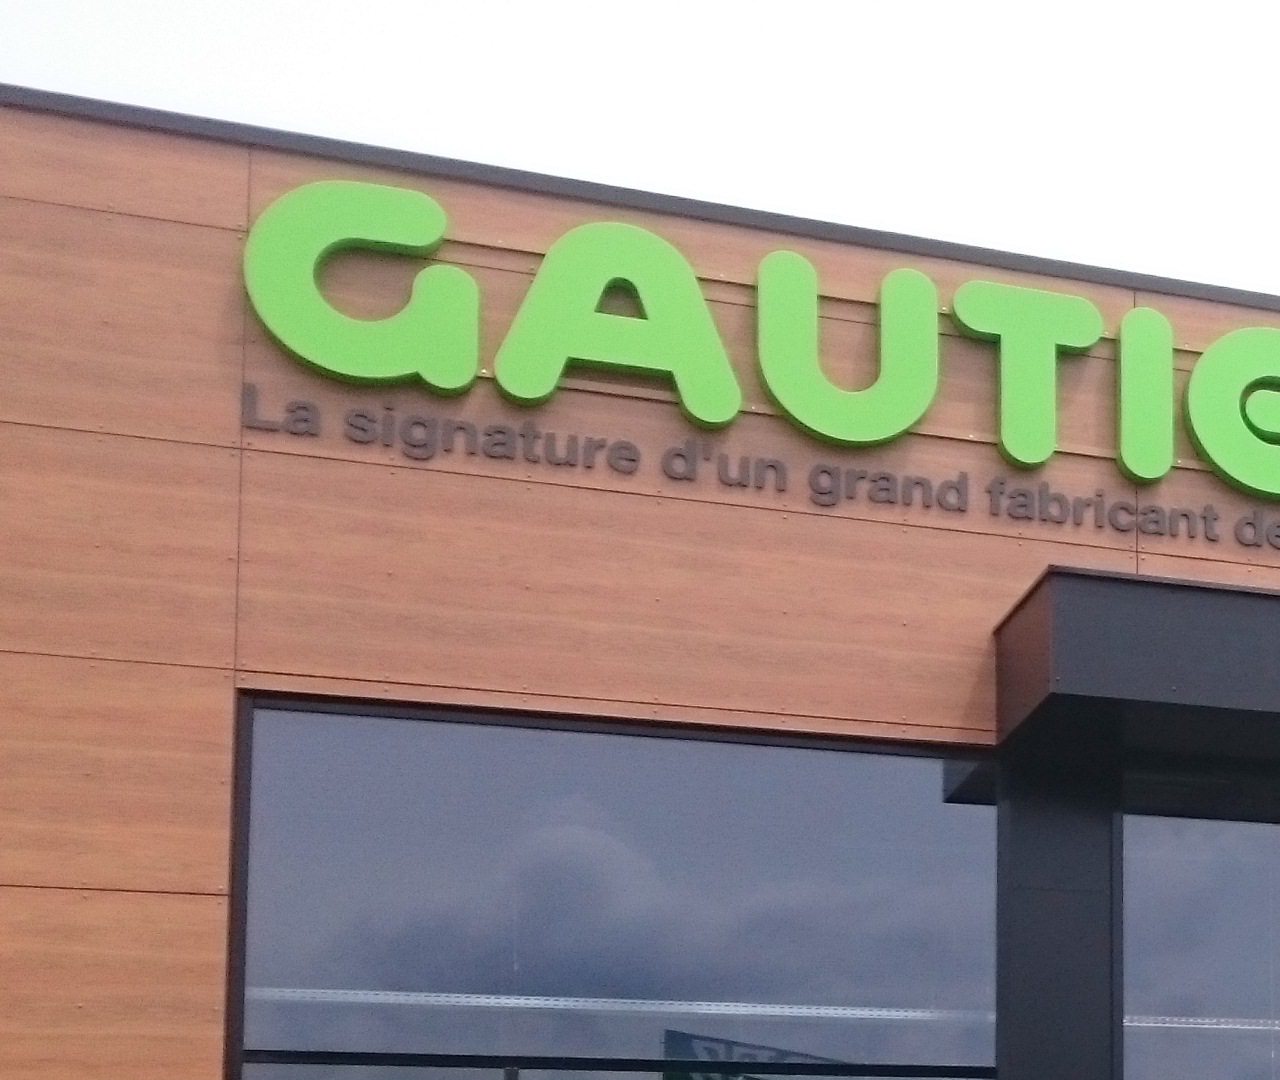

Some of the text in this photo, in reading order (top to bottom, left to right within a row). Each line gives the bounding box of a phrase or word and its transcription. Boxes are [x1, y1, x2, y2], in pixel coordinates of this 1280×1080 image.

[241, 382, 320, 437] La
[344, 400, 640, 475] signature
[661, 434, 788, 493] d'un
[808, 462, 968, 513] grand
[987, 478, 1219, 542] fabricant
